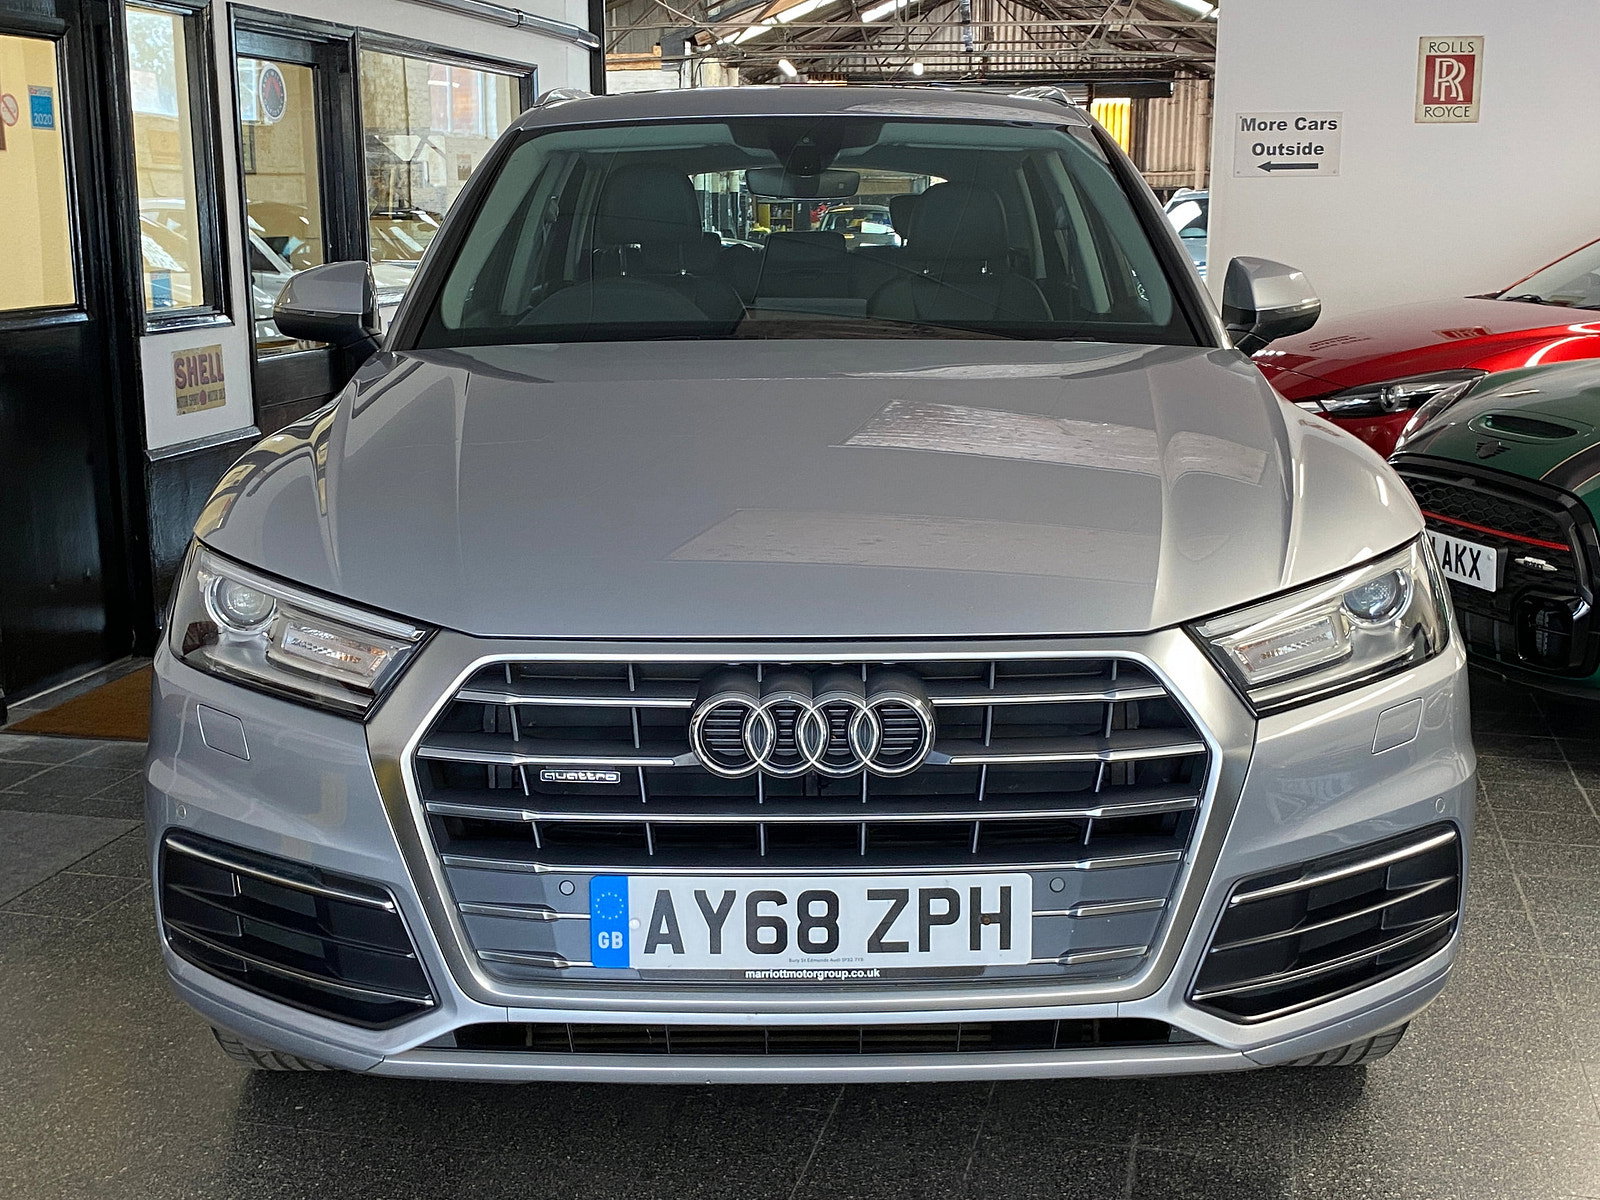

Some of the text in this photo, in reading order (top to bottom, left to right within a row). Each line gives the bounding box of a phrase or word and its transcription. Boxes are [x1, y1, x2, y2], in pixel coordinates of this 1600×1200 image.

[1428, 41, 1475, 53] ROLLS
[33, 112, 53, 125] 2020
[1424, 106, 1471, 118] ROYCE
[1241, 116, 1338, 132] More Cars
[1251, 142, 1325, 156] Outside
[174, 352, 225, 390] SHELL
[1441, 540, 1481, 581] AKX
[544, 771, 617, 781] quattro
[643, 885, 1012, 955] AY68 ZPH
[597, 931, 623, 949] GB
[745, 968, 880, 981] marriottmotorgroup.co.uk
